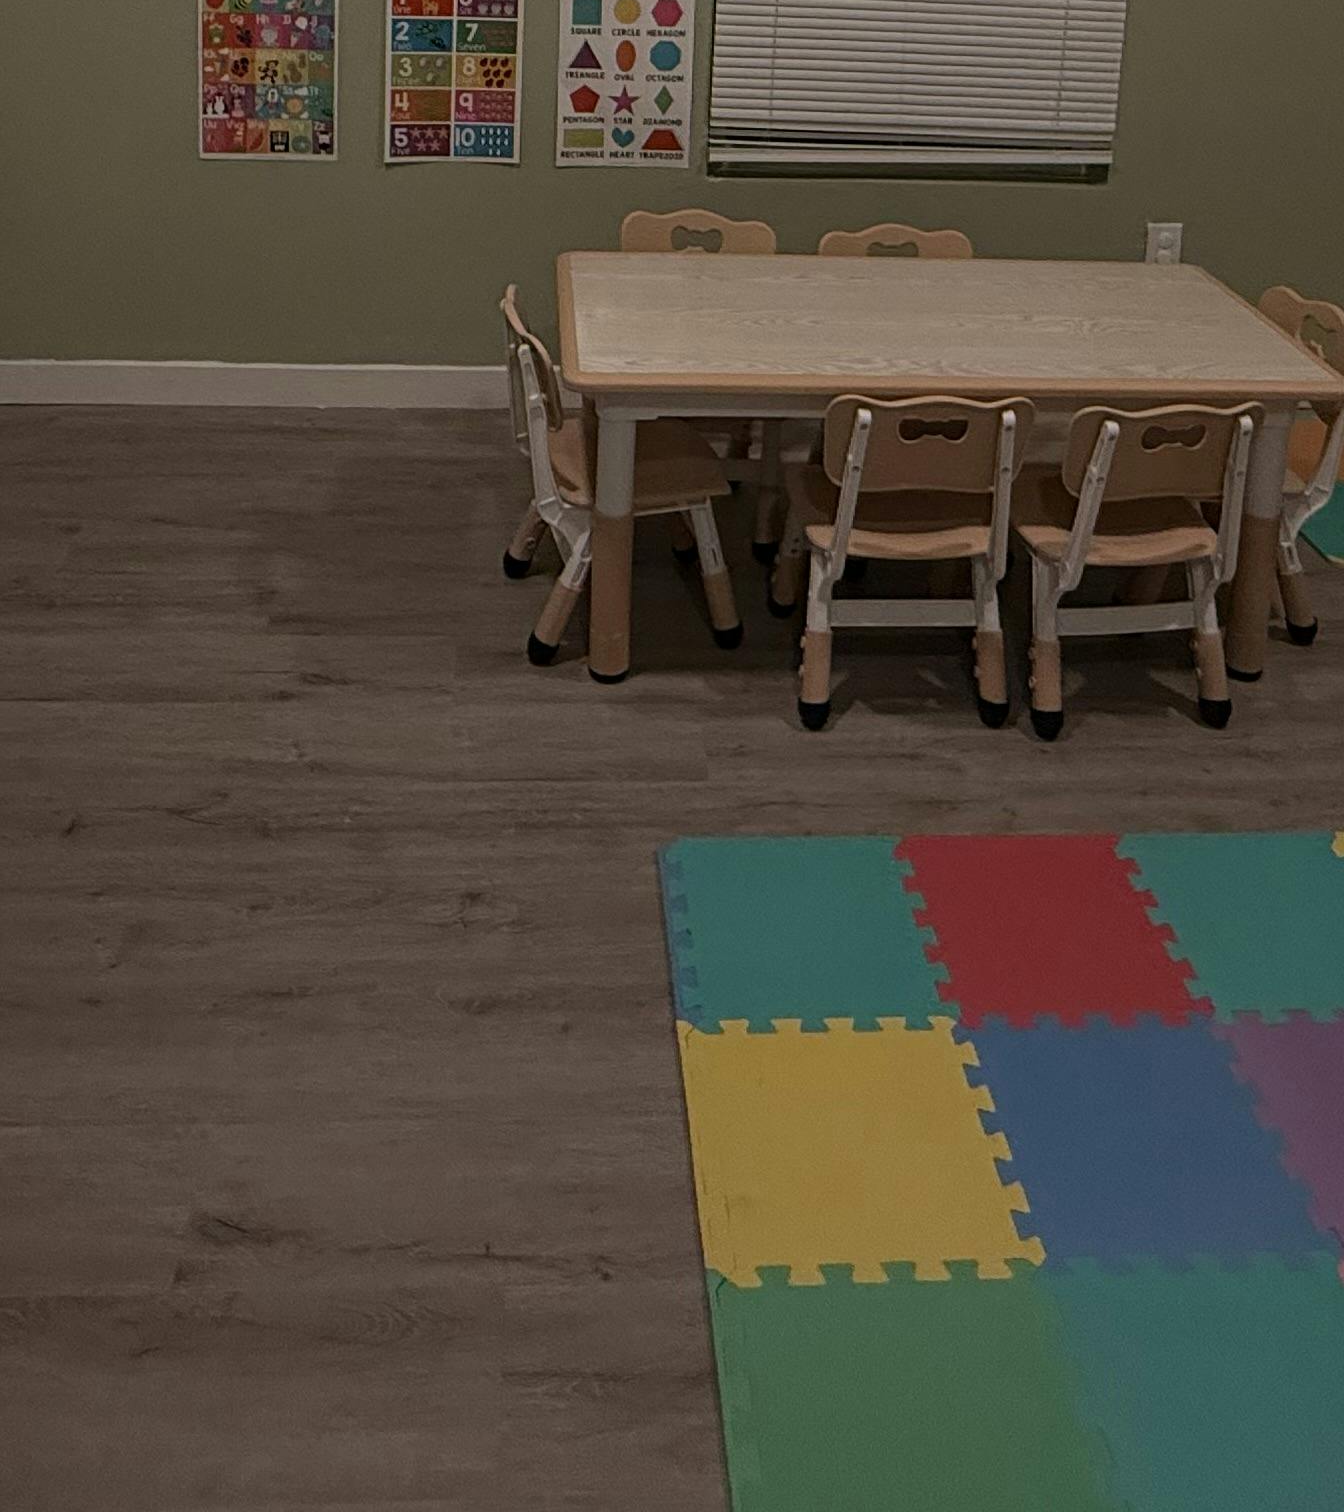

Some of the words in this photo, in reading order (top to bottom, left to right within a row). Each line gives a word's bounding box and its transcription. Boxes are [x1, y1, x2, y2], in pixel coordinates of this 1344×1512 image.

[395, 21, 409, 41] 2
[465, 23, 479, 42] 7
[570, 27, 602, 36] SQUARE
[611, 28, 641, 37] CIRCLE
[399, 57, 412, 77] 3
[463, 56, 476, 76] 8
[565, 71, 605, 80] TRIANGLE
[613, 74, 635, 82] OVAL
[395, 91, 410, 111] 4
[459, 92, 473, 112] 9
[613, 117, 633, 125] STAR
[394, 127, 408, 148] 5
[455, 127, 475, 147] 10
[560, 150, 605, 159] RECTANGLE
